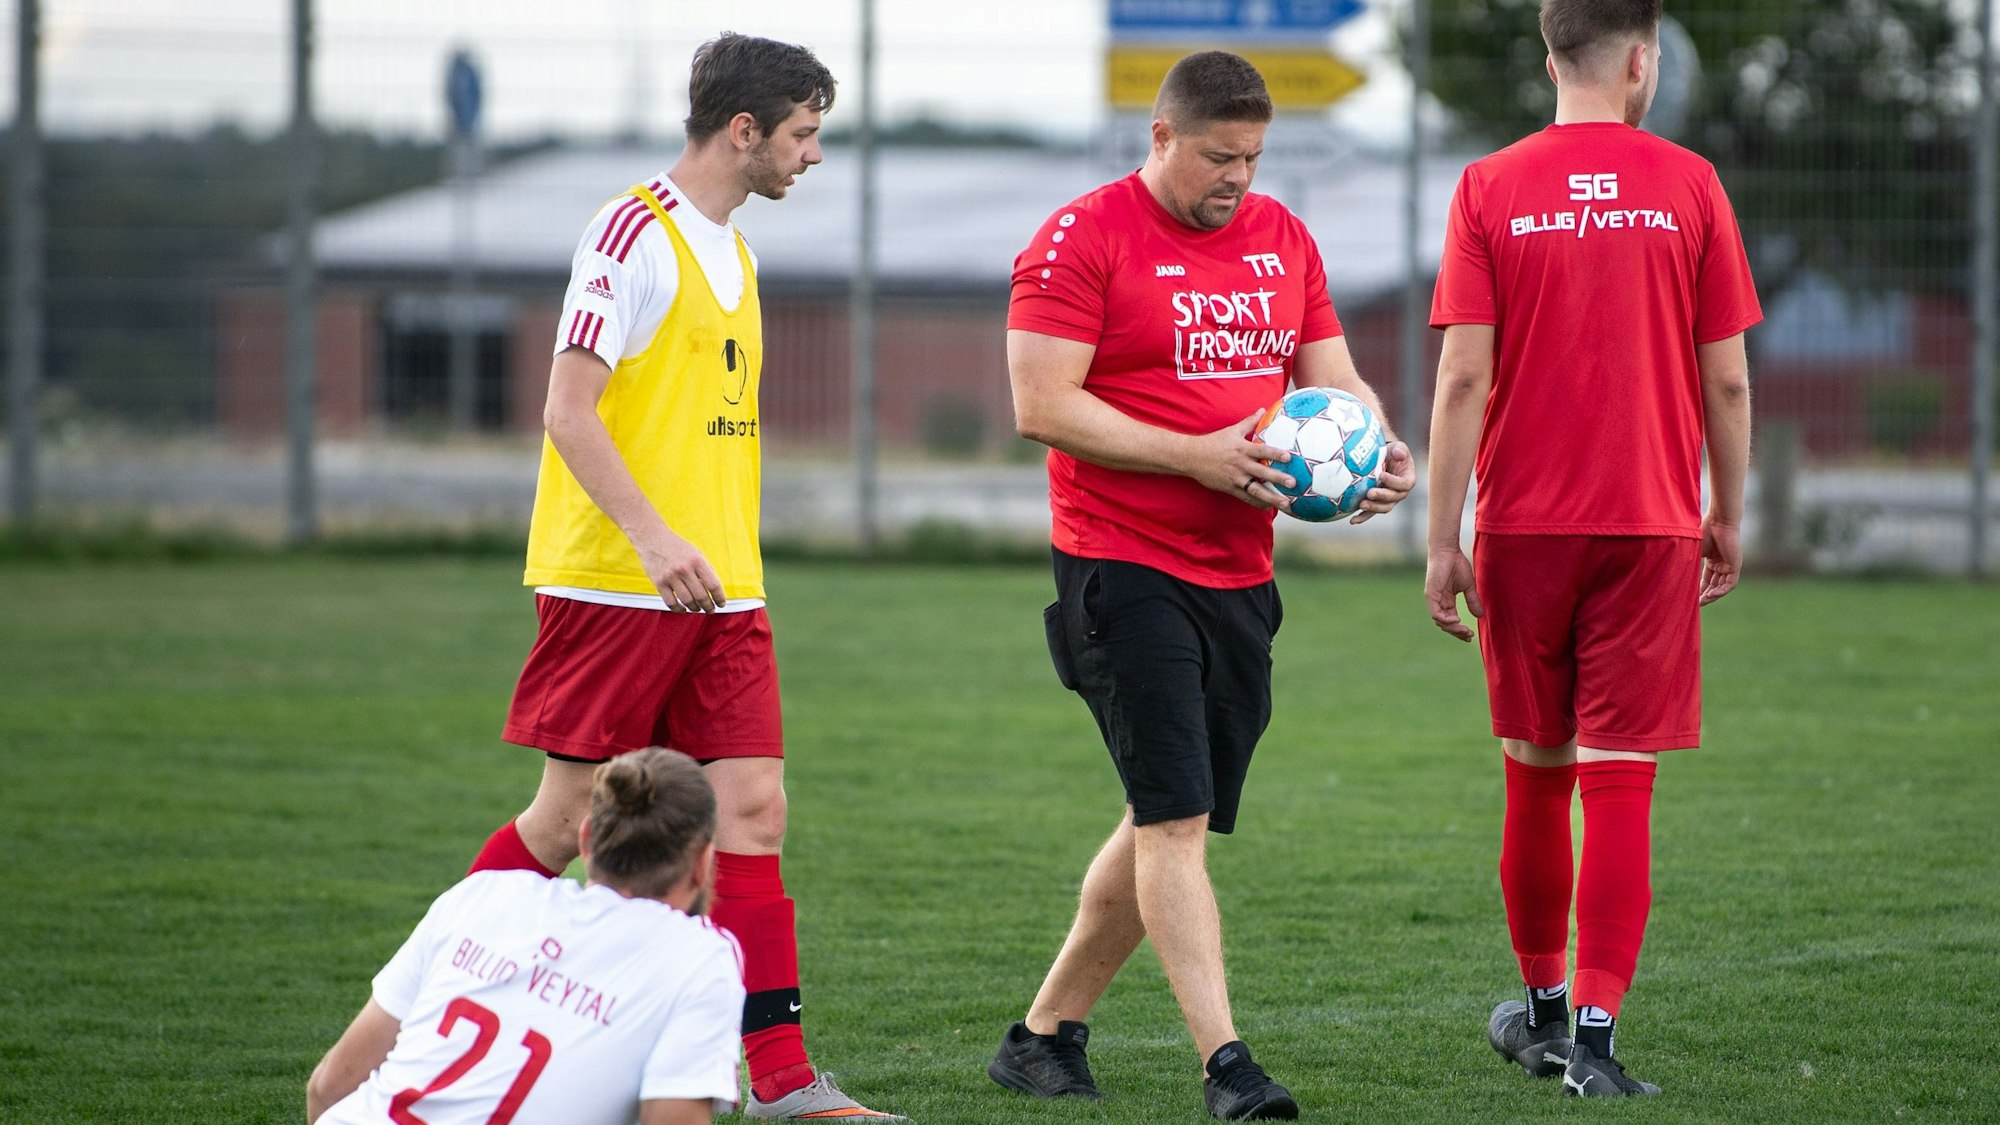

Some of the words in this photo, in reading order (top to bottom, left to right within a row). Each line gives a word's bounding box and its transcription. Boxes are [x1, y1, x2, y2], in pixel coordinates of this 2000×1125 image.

[1568, 173, 1618, 201] SG
[1155, 265, 1186, 277] JAKO
[1242, 253, 1286, 278] TR
[1171, 287, 1278, 328] SPORT
[1187, 325, 1297, 360] FRÖHLING
[528, 964, 617, 1027] VEYTAL
[388, 995, 552, 1125] 21
